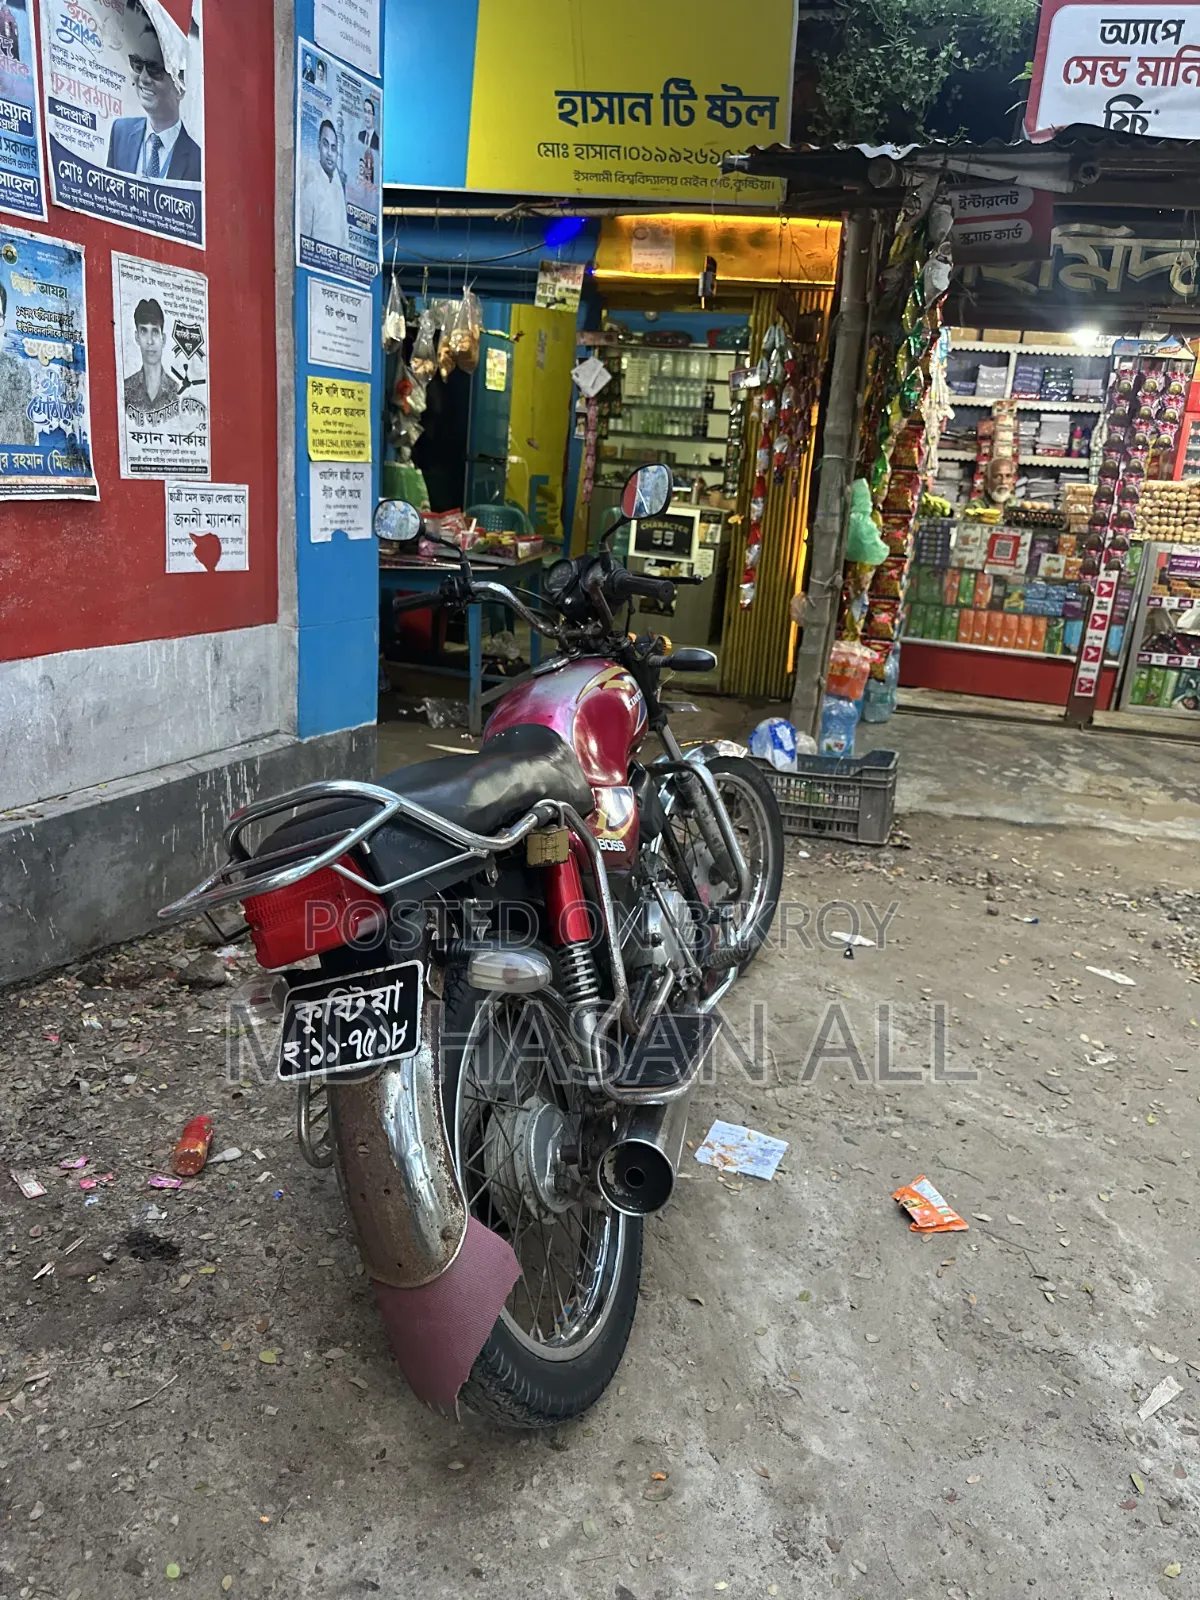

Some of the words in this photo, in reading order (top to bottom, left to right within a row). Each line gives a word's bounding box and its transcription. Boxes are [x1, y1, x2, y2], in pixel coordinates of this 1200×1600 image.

[1100, 19, 1185, 45] অ্যাপে
[1062, 56, 1131, 88] সেন্ড
[51, 71, 122, 119] চেয়ারম্যান
[555, 90, 653, 127] হাসান
[661, 78, 697, 127] টি
[705, 84, 779, 130] ষ্টল
[55, 104, 93, 128] পদপ্রার্থী
[537, 142, 569, 159] মোঃ
[573, 170, 612, 183] ইসলামী
[615, 170, 678, 186] বিশ্ববিদ্যালয়
[680, 174, 707, 188] মেইন
[58, 160, 83, 184] মোঃ
[87, 169, 125, 198] সোহেল
[129, 182, 150, 206] রানা
[154, 189, 196, 224] (সোহেল)
[958, 190, 1020, 210] ইন্টারনেট
[994, 223, 1023, 241] কার্ড
[301, 237, 315, 252] মোঃ
[316, 243, 339, 260] সোহেল
[339, 250, 353, 265] রানা
[353, 255, 379, 276] (সোহেল)
[37, 282, 68, 299] আযহা
[312, 381, 323, 396] সিট
[325, 383, 339, 398] খালি
[340, 387, 356, 400] আছে
[127, 403, 145, 427] মোঃ
[145, 400, 180, 427] আনোয়ার
[181, 396, 206, 421] হোসেন
[312, 402, 342, 416] বি.এম.এস
[196, 422, 206, 431] -কে
[129, 431, 163, 445] ফ্যান
[167, 431, 207, 448] মার্কায়
[10, 452, 44, 471] রহমান
[169, 489, 183, 503] ছাত্রী
[185, 493, 198, 503] মেস
[199, 493, 214, 504] ভাড়া
[216, 494, 233, 504] দেওয়া
[234, 495, 245, 504] হবে
[173, 507, 202, 528] জননী
[205, 513, 242, 528] ম্যানশন
[597, 838, 627, 852] BOSS
[293, 979, 404, 1034] কুষ্টিয়া
[283, 1019, 409, 1069] হ-১১-৭৫১৮
